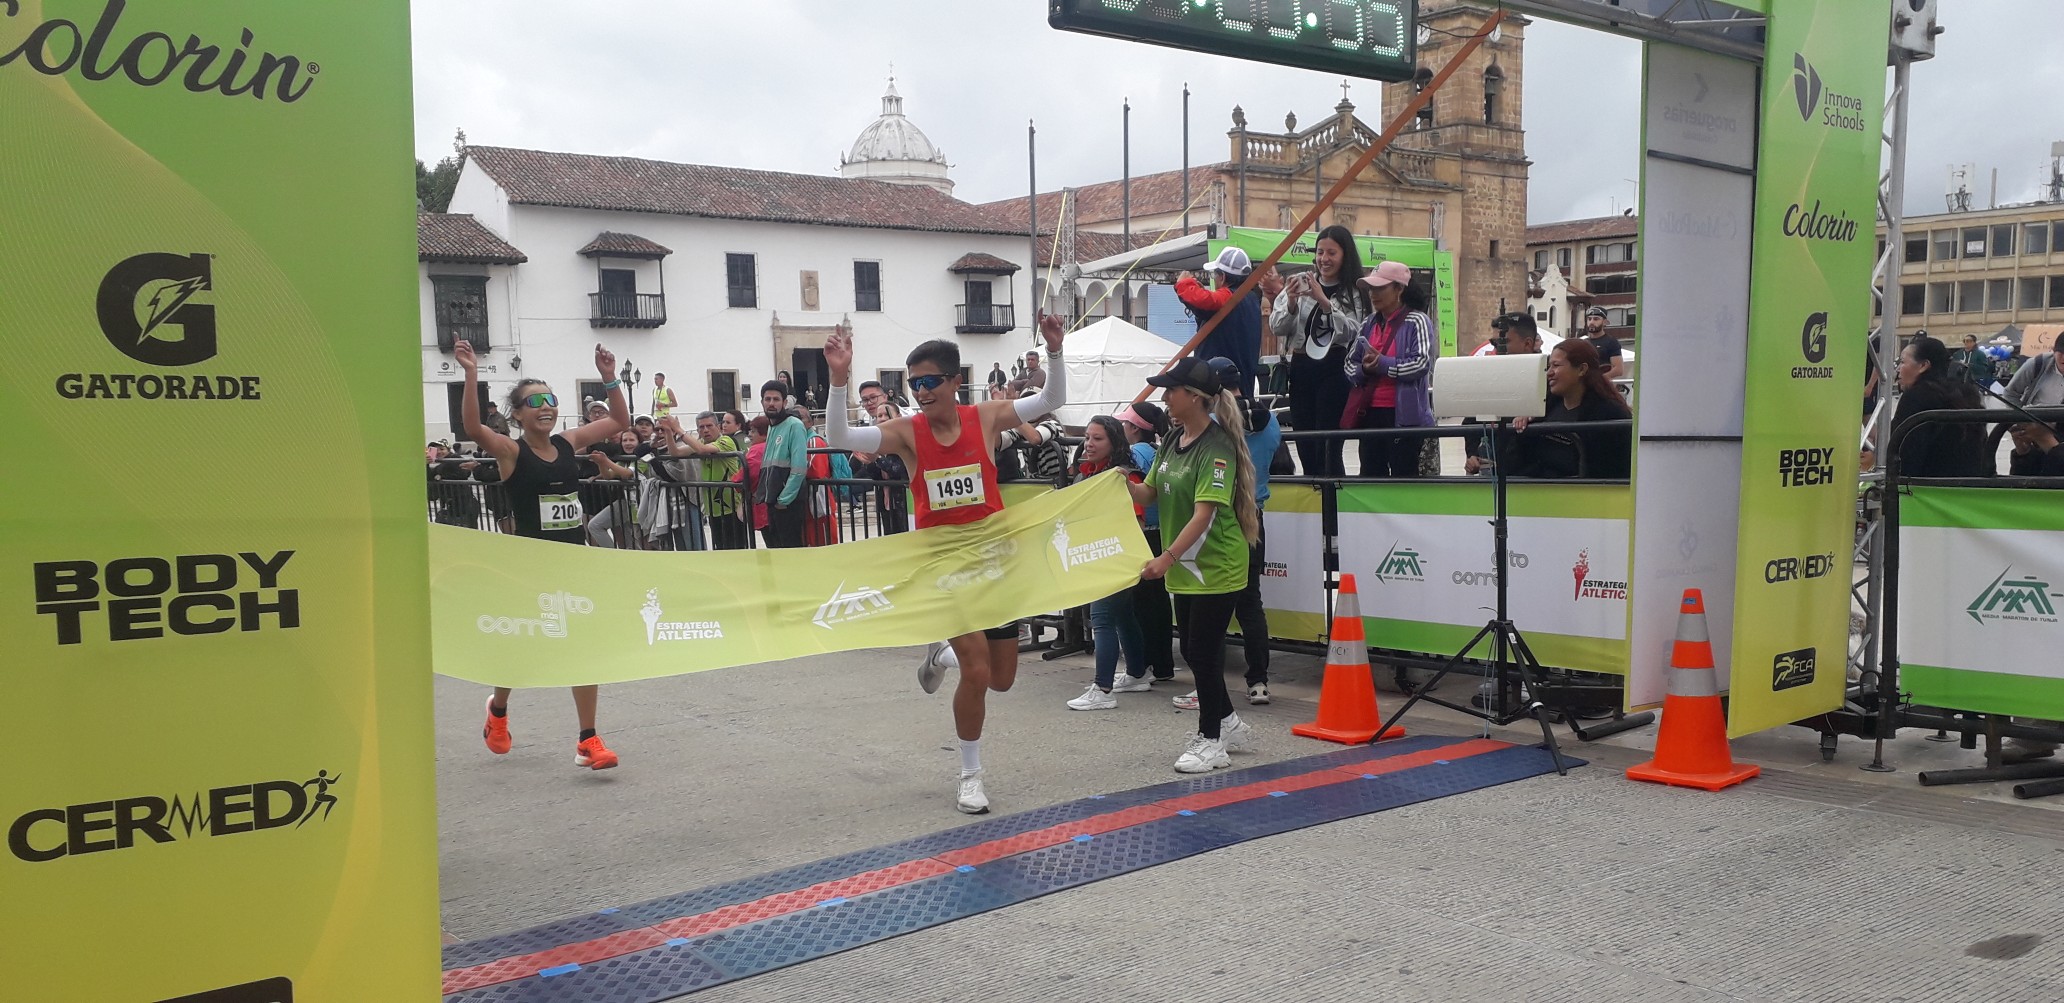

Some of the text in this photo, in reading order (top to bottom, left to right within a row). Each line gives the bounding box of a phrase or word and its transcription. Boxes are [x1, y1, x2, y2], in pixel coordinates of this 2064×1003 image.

[1824, 87, 1862, 111] Innova
[1823, 107, 1864, 131] Schools
[1782, 199, 1857, 242] Colorin
[1791, 366, 1834, 379] GATORADE
[56, 373, 261, 400] GATORADE
[1779, 447, 1834, 468] BODY
[1213, 468, 1225, 480] 5K
[1779, 466, 1834, 488] TECH
[936, 476, 974, 499] 1499
[1067, 535, 1120, 556] ESTRATEGIA
[1070, 543, 1124, 567] ATLETICA
[1263, 561, 1288, 569] RATEGIA
[33, 549, 296, 604] BODY
[1582, 579, 1628, 590] ESTRATEGI
[35, 589, 301, 646] TECH
[656, 620, 721, 630] ESTRATEGIA
[656, 628, 724, 641] ATLETICA
[1793, 658, 1814, 674] FCA
